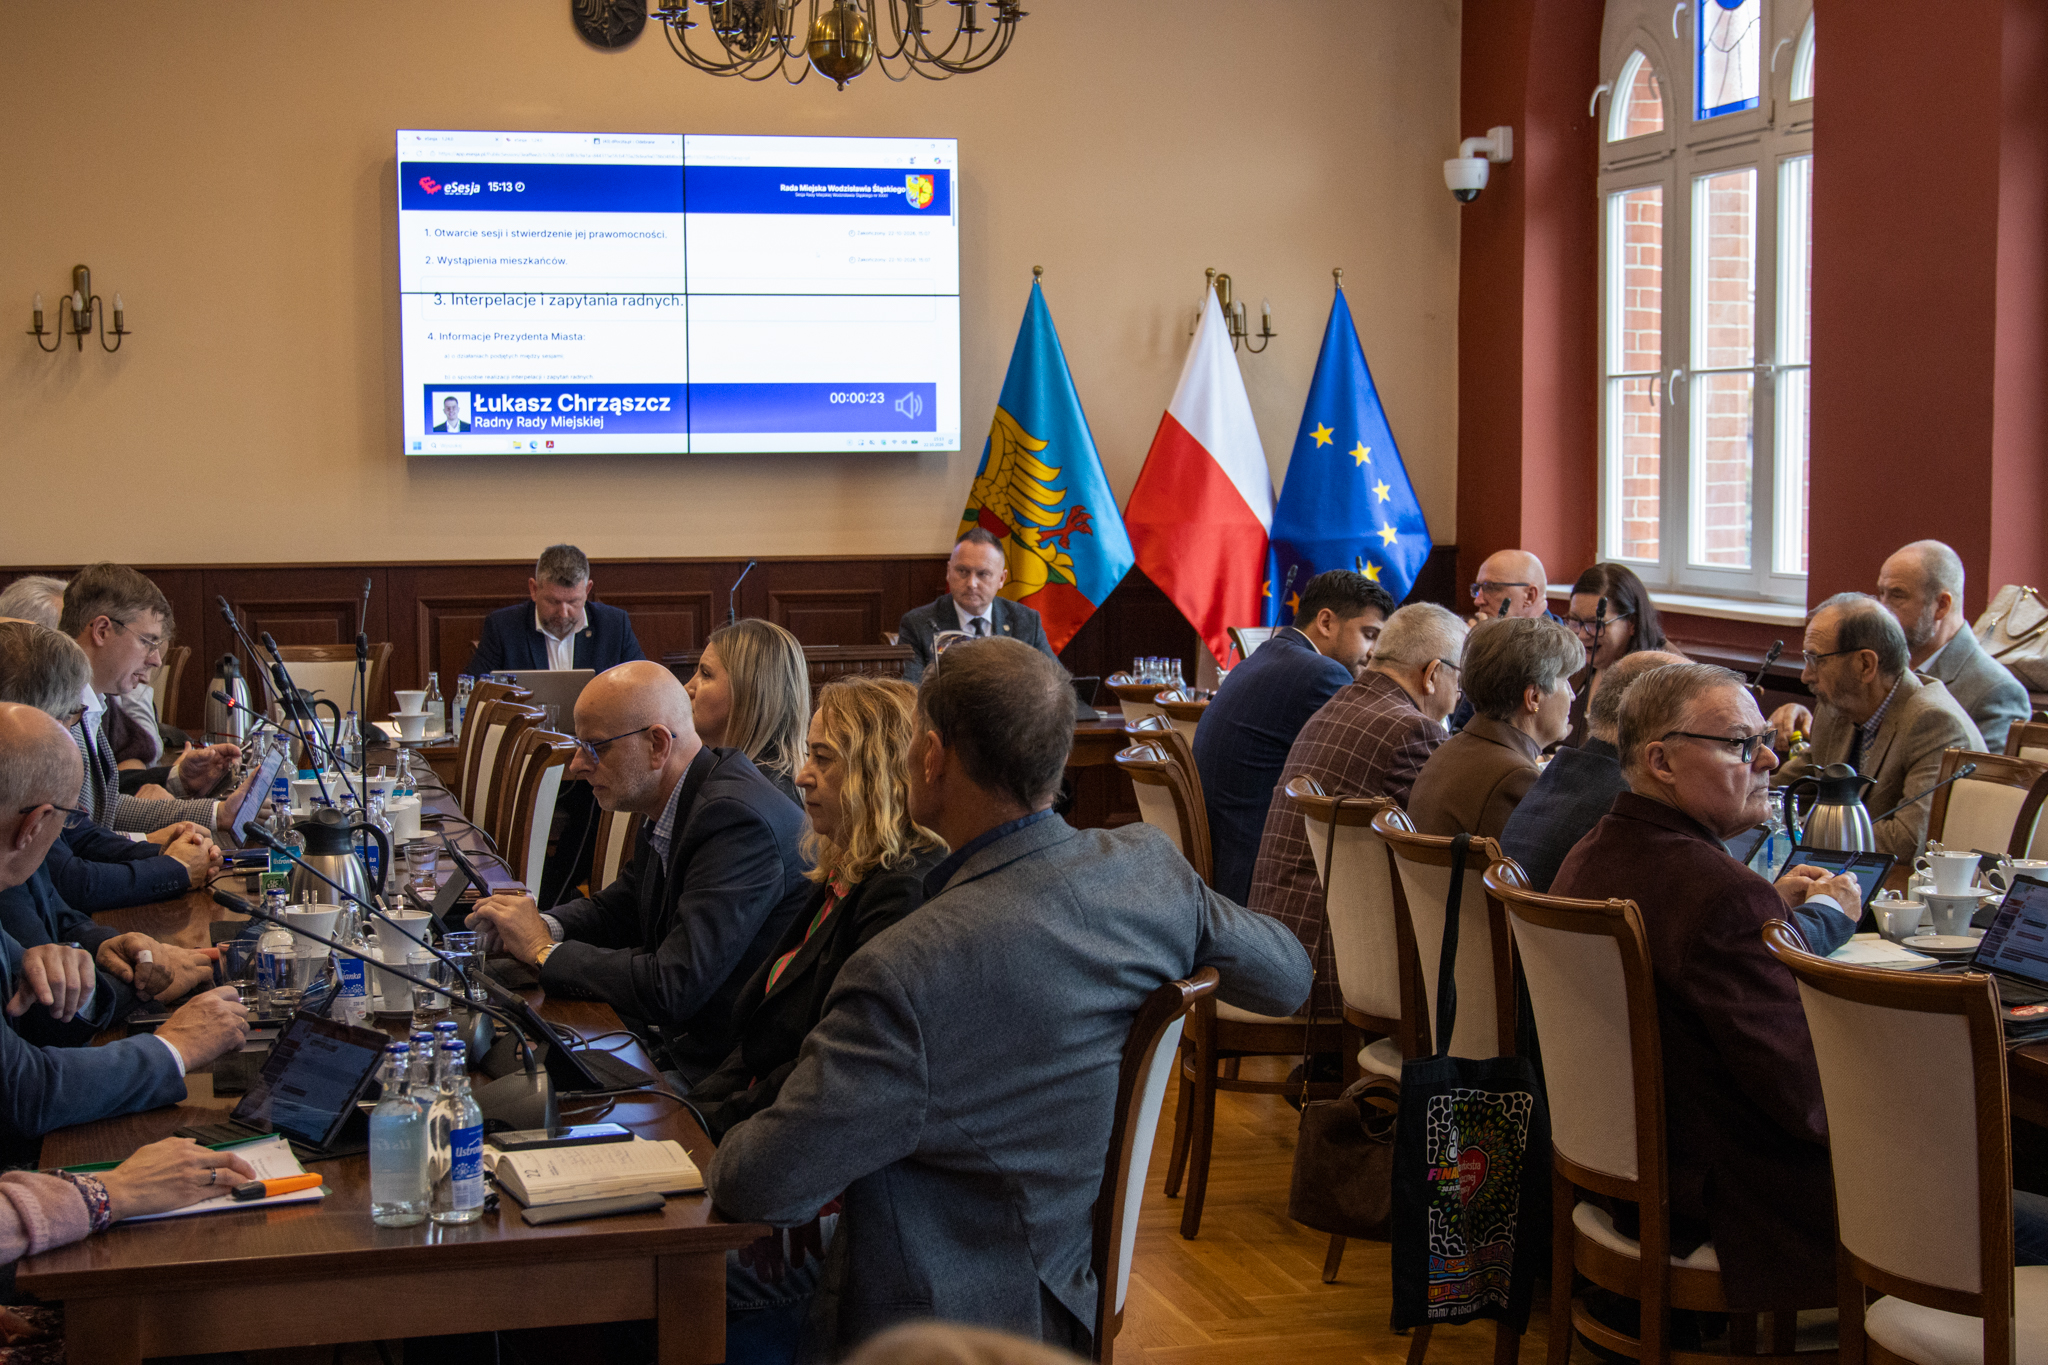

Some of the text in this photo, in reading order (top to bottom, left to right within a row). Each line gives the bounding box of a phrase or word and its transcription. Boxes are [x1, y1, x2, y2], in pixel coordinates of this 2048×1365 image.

[444, 181, 481, 196] eSesja
[487, 181, 513, 192] 15:13
[780, 183, 906, 194] Rada Miejska Wodzisławia Śląskiego
[424, 228, 432, 237] 1.
[434, 228, 478, 238] Otwarcie
[481, 229, 503, 240] sesji
[511, 229, 573, 238] stwierdzenie
[574, 230, 587, 240] jej
[589, 229, 667, 240] prawomocności.
[425, 256, 568, 267] 2. Wystąpienia mieszkańców.
[433, 293, 446, 306] 3.
[451, 293, 536, 309] Interpelacje
[549, 293, 617, 309] zapytania
[622, 293, 684, 309] radnych.
[427, 332, 586, 343] 4. Informacje Prezydenta Miasta:
[830, 391, 885, 404] 00:00:23
[474, 393, 671, 416] Łukasz Chrząszcz
[474, 416, 604, 430] Radny Rady Miejskiej
